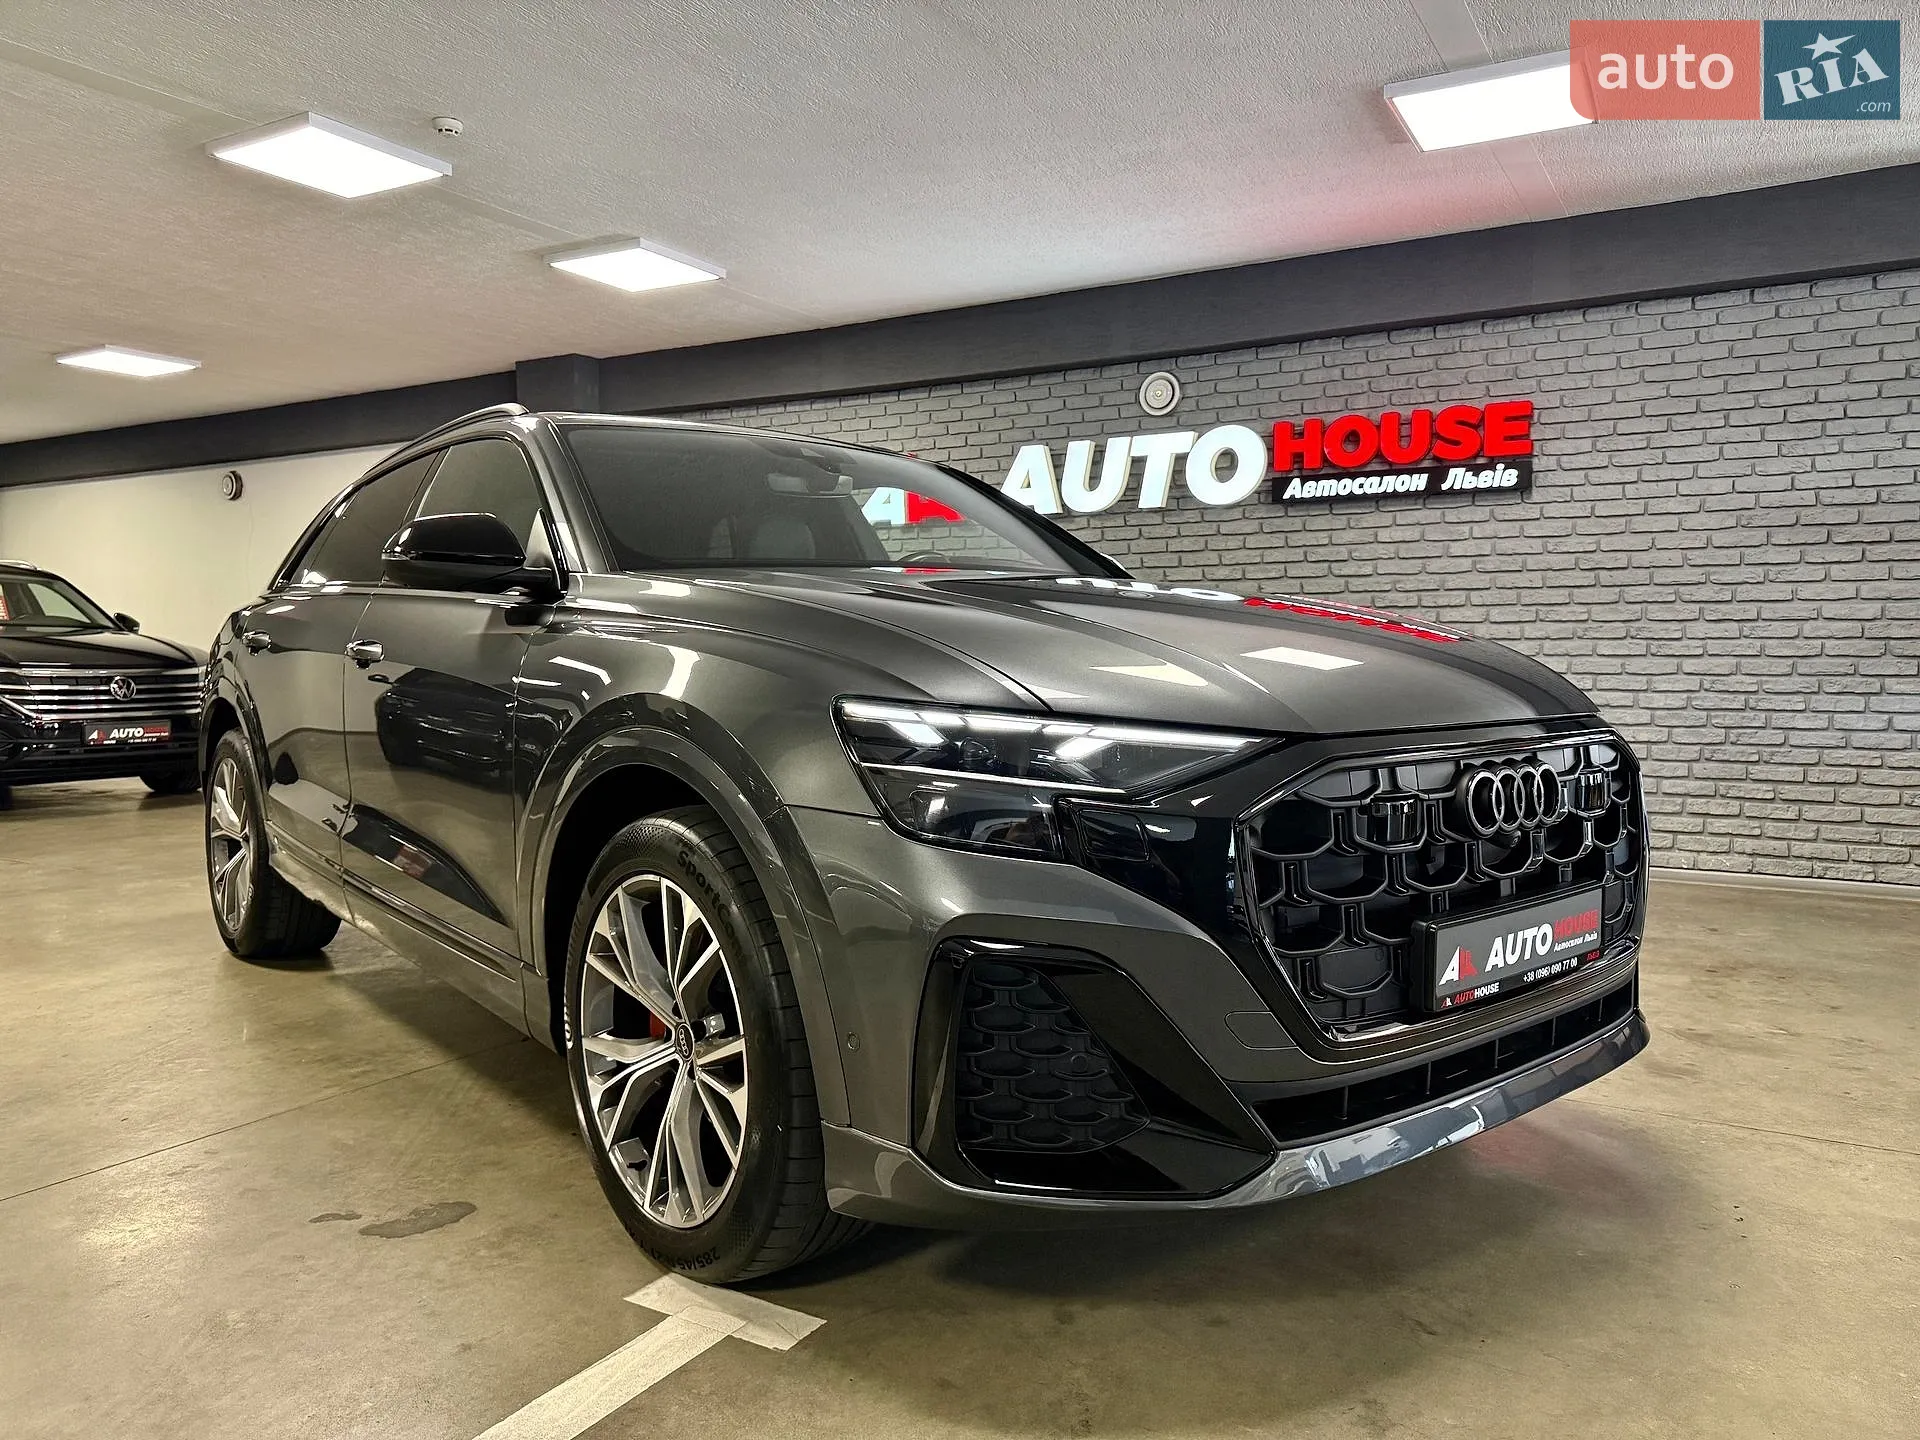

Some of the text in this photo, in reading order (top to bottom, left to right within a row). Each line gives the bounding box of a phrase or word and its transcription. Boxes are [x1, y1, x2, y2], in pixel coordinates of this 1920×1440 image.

[1000, 400, 1533, 515] AUTO HOUSE
[1282, 461, 1518, 500] Автосалон Львів
[109, 727, 144, 739] AUTO
[1484, 909, 1599, 973] AUTO HOUSE
[1523, 971, 1535, 983] +38
[1562, 959, 1570, 970] 77
